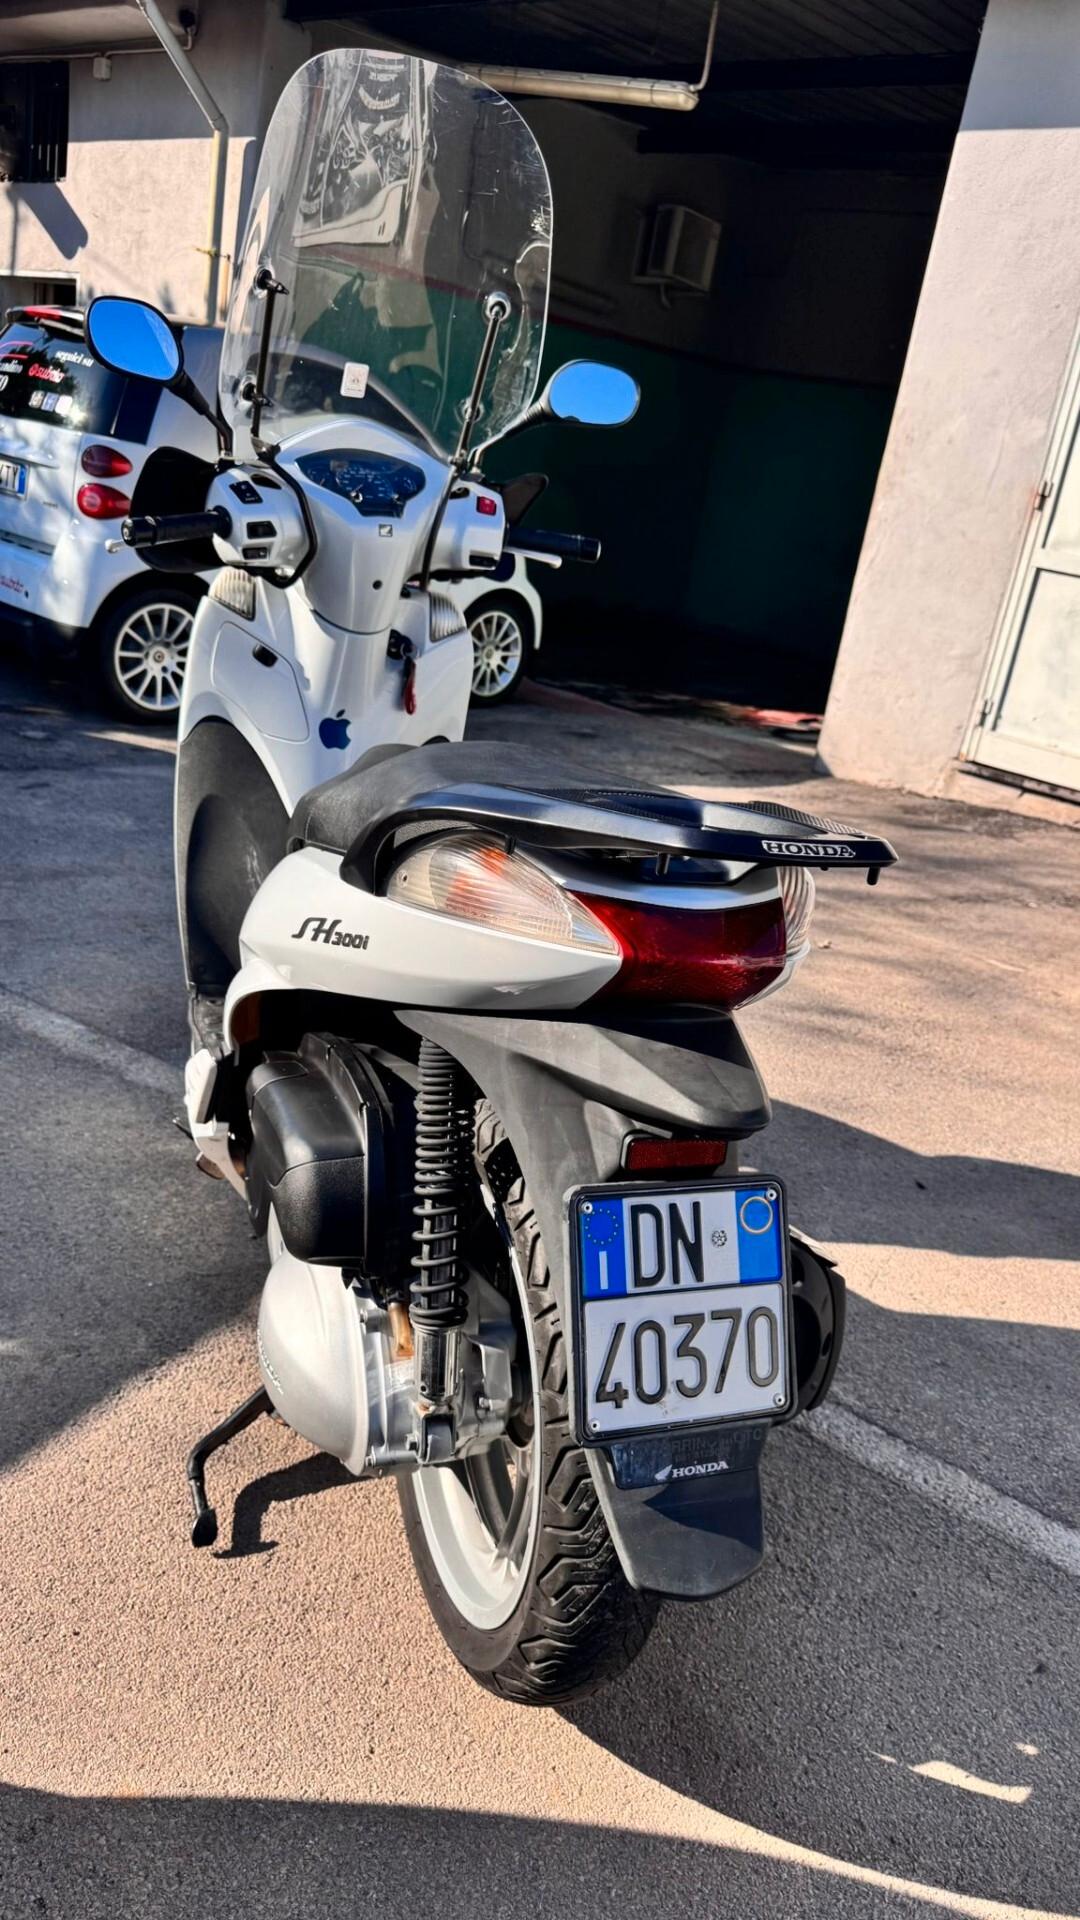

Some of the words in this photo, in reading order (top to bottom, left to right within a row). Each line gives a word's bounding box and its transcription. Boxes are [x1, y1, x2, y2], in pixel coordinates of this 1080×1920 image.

[763, 840, 856, 858] HONDA
[630, 1201, 704, 1288] DN
[595, 1306, 779, 1409] 40370
[671, 1460, 729, 1478] HONDA
